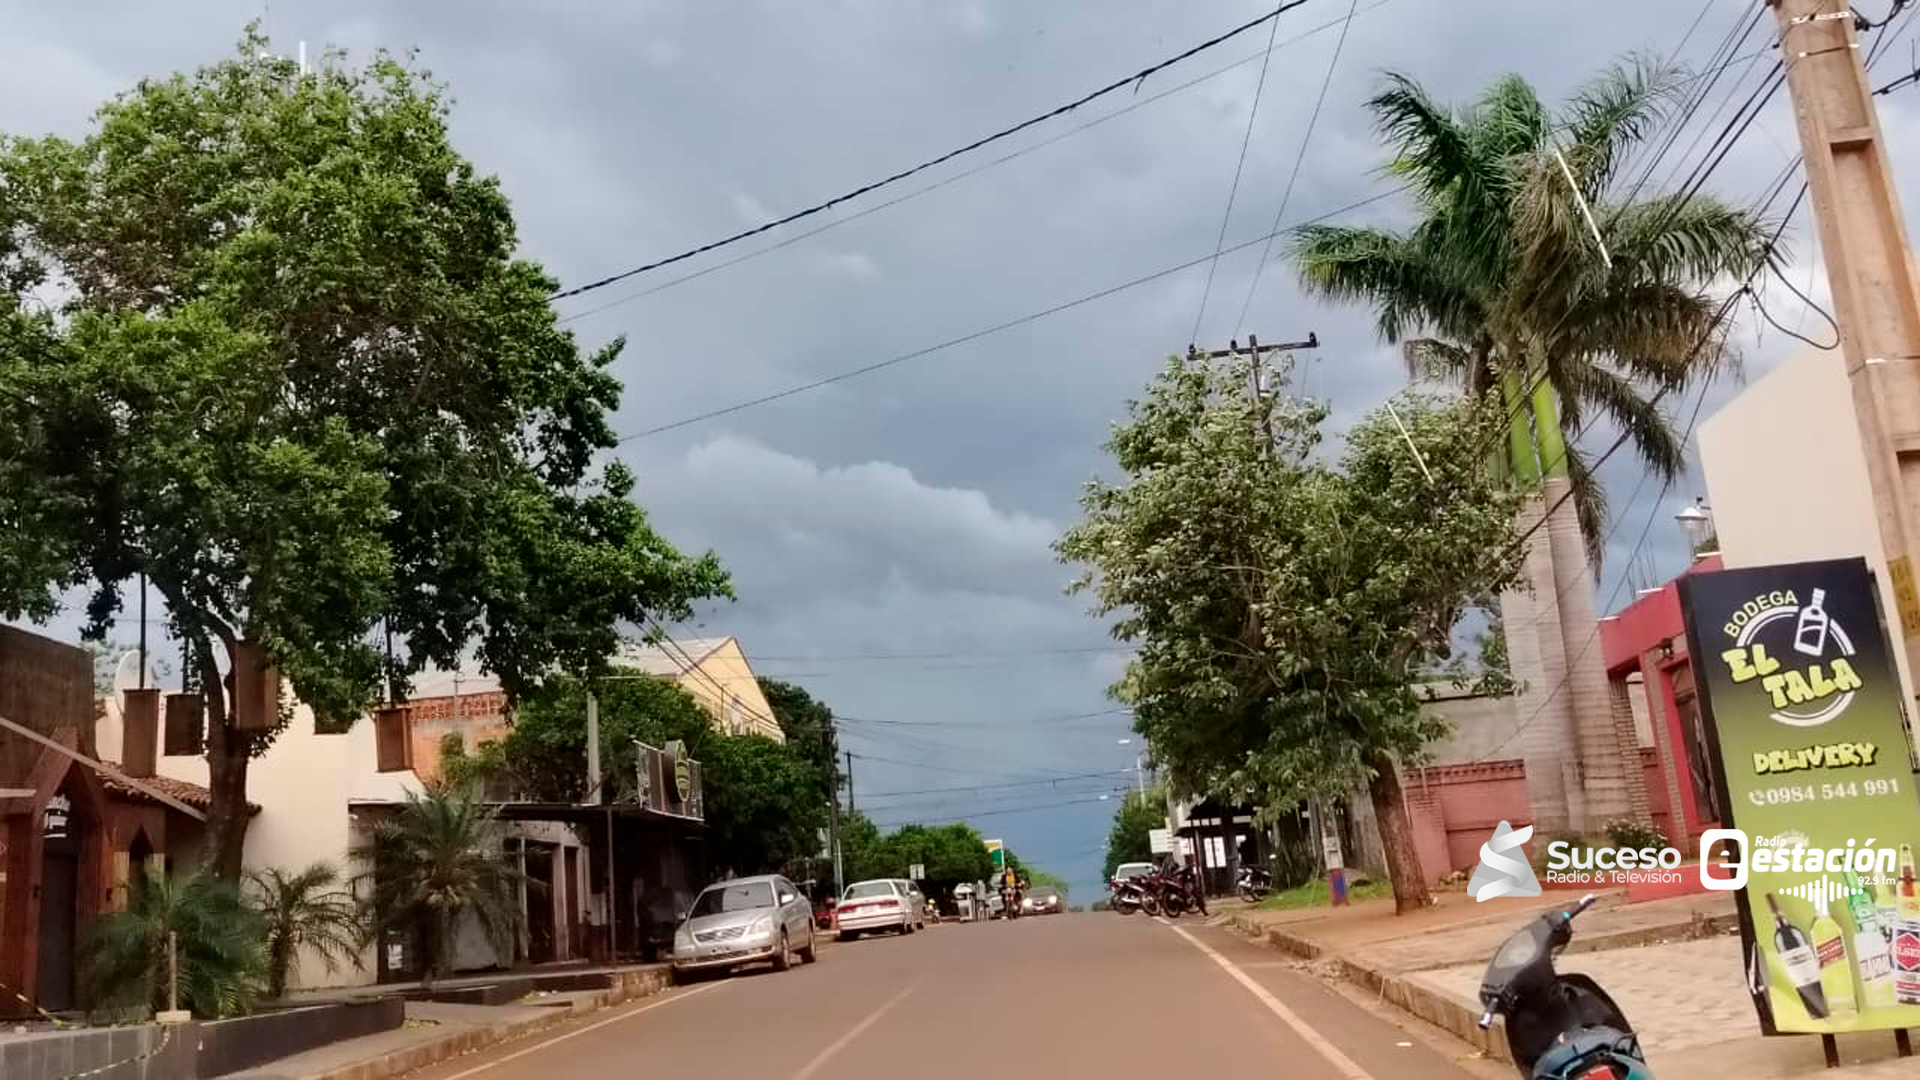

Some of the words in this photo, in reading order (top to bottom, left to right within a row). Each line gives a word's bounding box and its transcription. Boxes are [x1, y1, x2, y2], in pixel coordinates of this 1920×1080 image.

[1723, 589, 1799, 638] BODEGA
[1720, 643, 1781, 683] EL
[1762, 657, 1863, 710] TALA
[1752, 742, 1878, 774] DELIVERY
[1766, 783, 1816, 806] 0984
[1822, 781, 1859, 800] 544
[1863, 778, 1900, 797] 991
